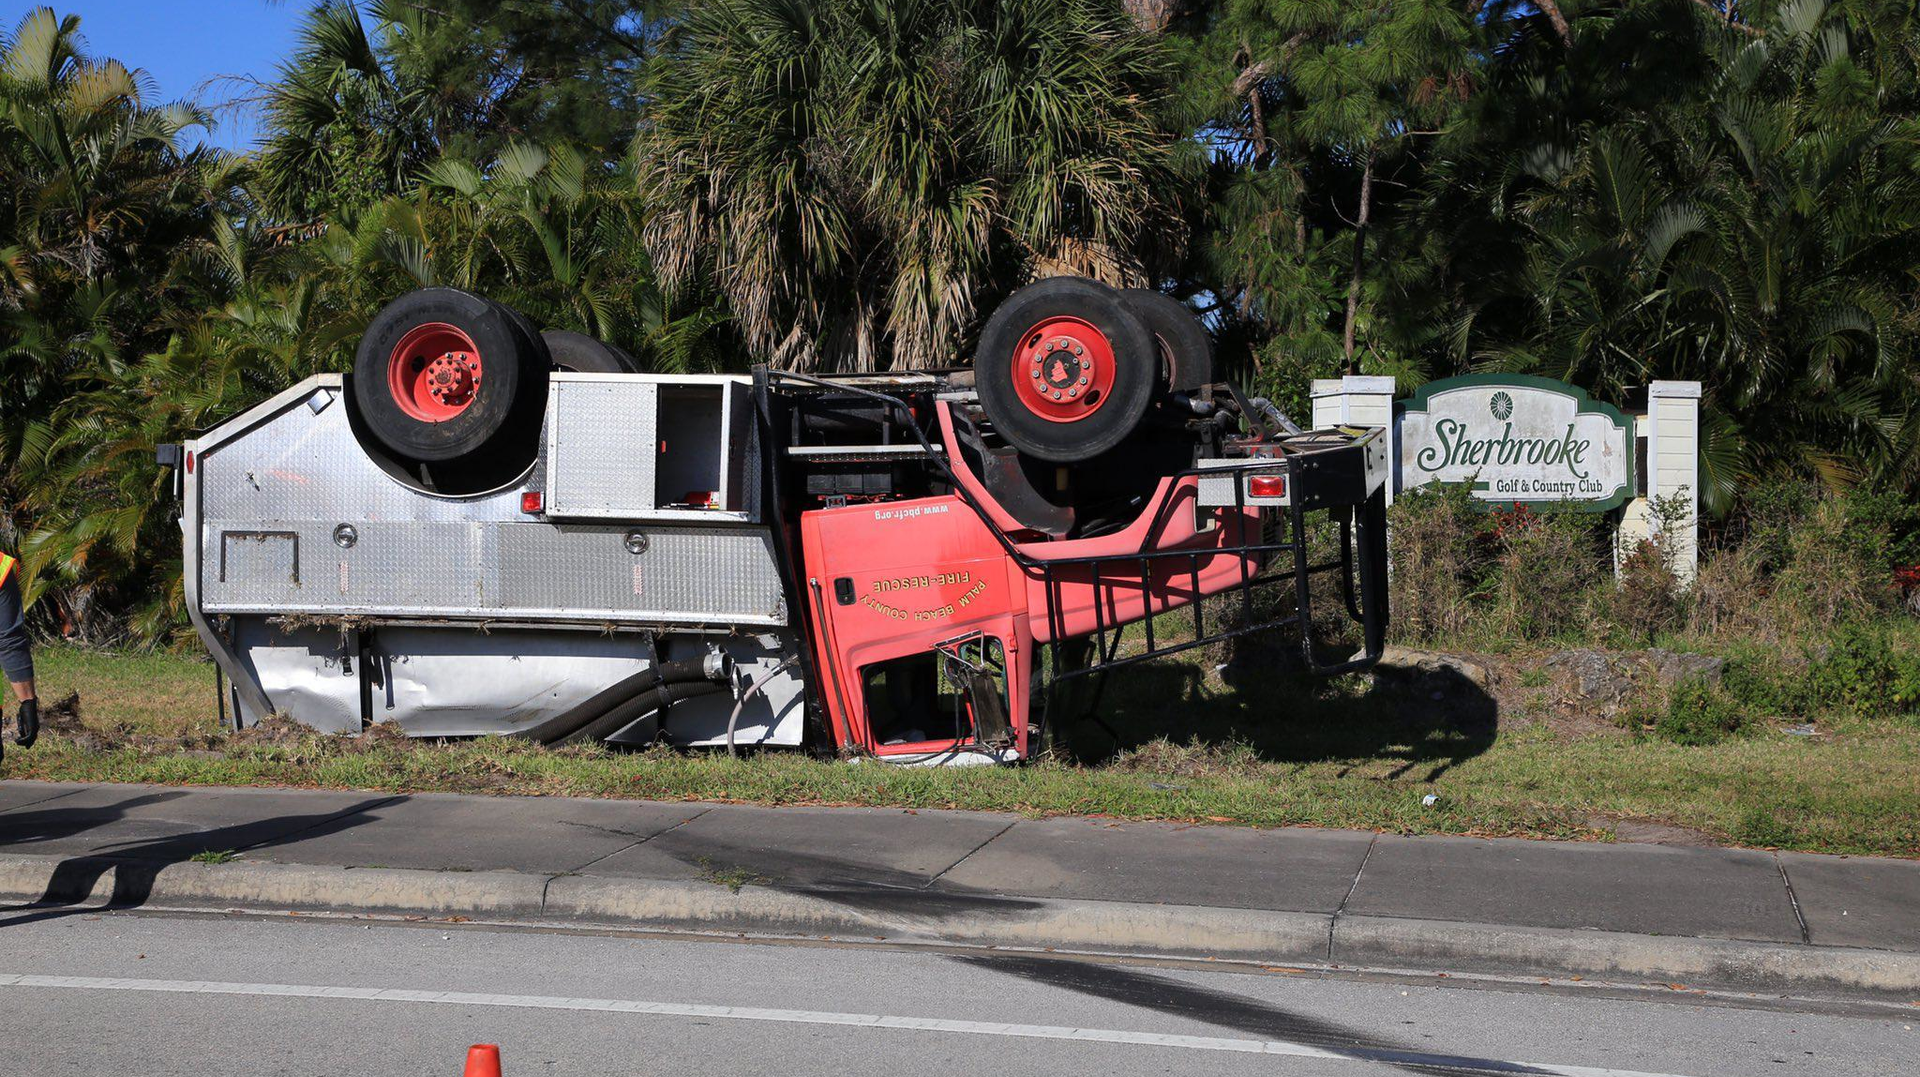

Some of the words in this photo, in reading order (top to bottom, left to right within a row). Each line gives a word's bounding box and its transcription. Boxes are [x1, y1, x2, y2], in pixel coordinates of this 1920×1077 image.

[1417, 418, 1591, 479] Sherbrooke
[1496, 479, 1520, 493] Golf
[1521, 480, 1530, 493] &
[1532, 479, 1575, 496] Country
[1579, 479, 1603, 493] Club
[875, 505, 948, 520] www.pbcfr.org
[873, 570, 970, 592] FIRE-RESCUE
[958, 580, 987, 607] PALM
[860, 593, 909, 621] COUNTY
[914, 603, 955, 621] BEACH
